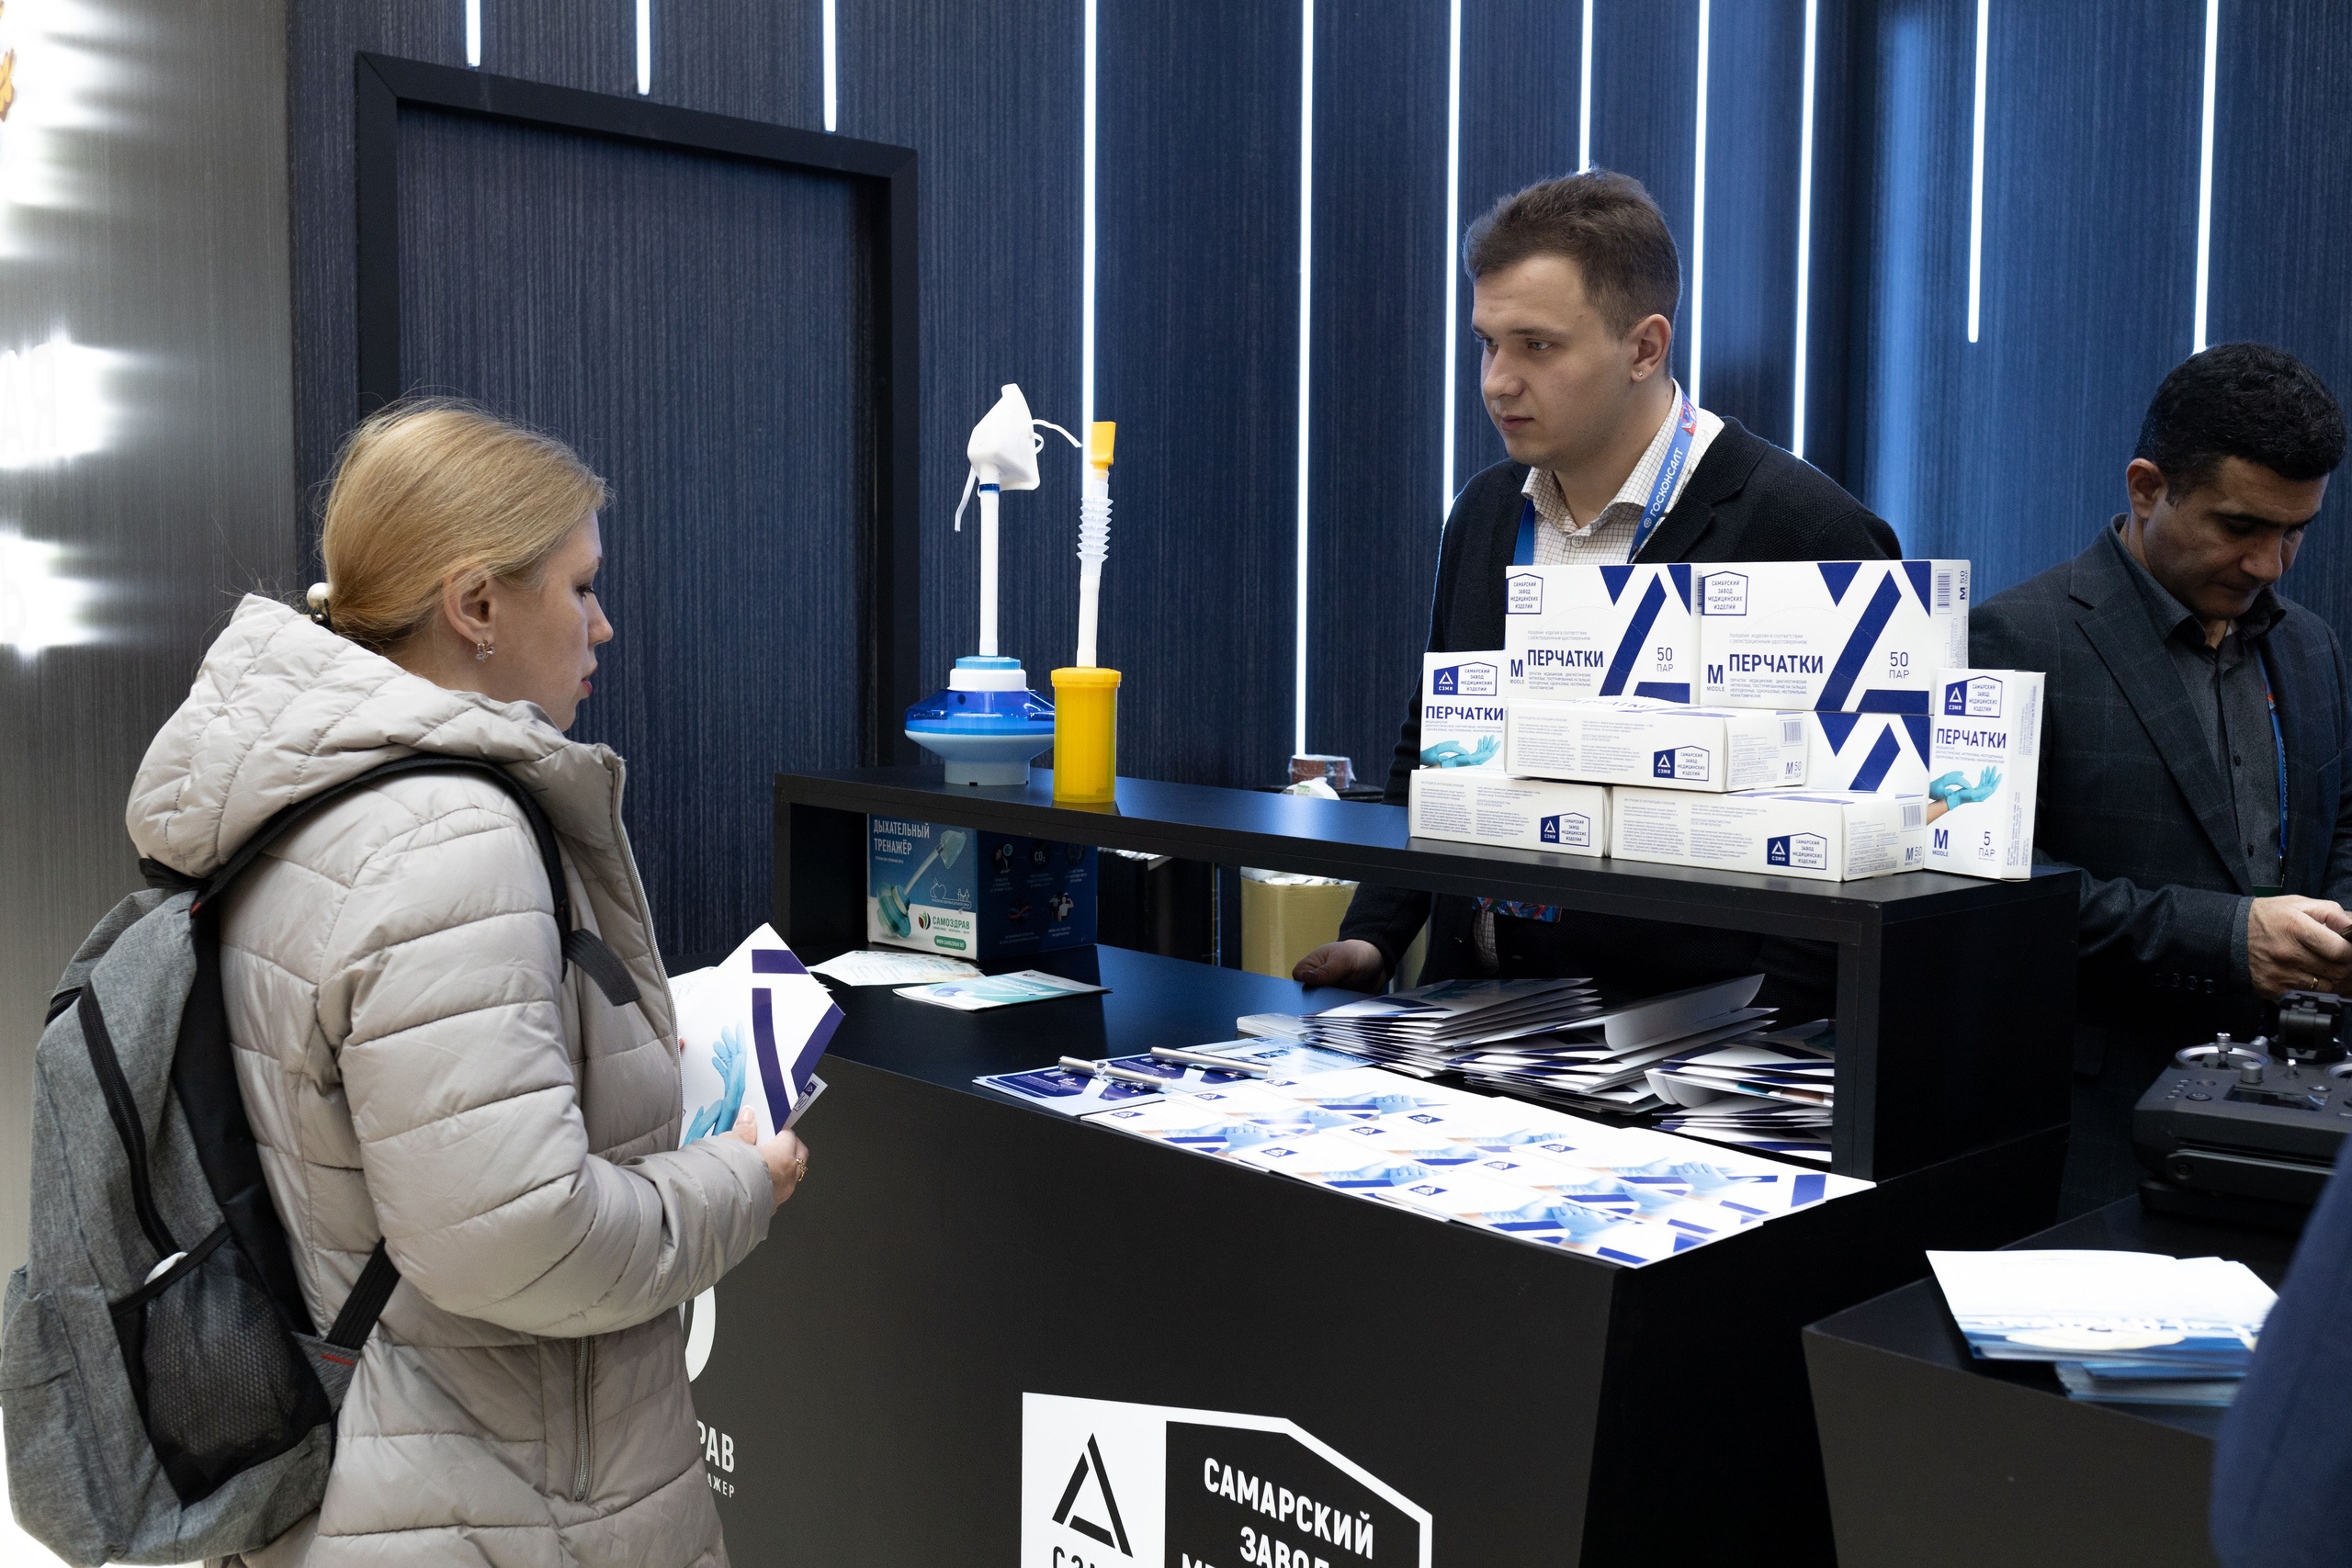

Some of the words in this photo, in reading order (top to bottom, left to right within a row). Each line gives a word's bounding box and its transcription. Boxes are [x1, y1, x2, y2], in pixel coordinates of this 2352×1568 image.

[1650, 447, 1683, 517] ГОСКОНСАЛТ
[1960, 587, 1965, 600] M
[1528, 649, 1603, 668] ПЕРЧАТКИ
[1657, 648, 1673, 661] 50
[1890, 652, 1908, 667] 50
[1510, 660, 1523, 677] M
[1657, 663, 1673, 672] ПАР
[1729, 654, 1823, 673] ПЕРЧАТКИ
[1708, 664, 1724, 683] M
[1889, 670, 1909, 679] ПАР
[1426, 705, 1504, 721] ПЕРЧАТКИ
[1937, 728, 2007, 749] ПЕРЧАТКИ
[1785, 761, 1793, 774] M
[1794, 761, 1802, 772] 50
[874, 819, 930, 839] ДЫХАТЕЛЬНЫЙ
[874, 838, 912, 855] ТРЕНАЖЁР
[1934, 829, 1949, 850] M
[1984, 831, 1991, 846] 5
[1905, 847, 1914, 862] M
[1915, 846, 1922, 857] 50
[1978, 848, 1995, 857] ПАР
[933, 916, 969, 930] САМОЗДРАВ
[1204, 1457, 1374, 1560] САМАРСКИЙ
